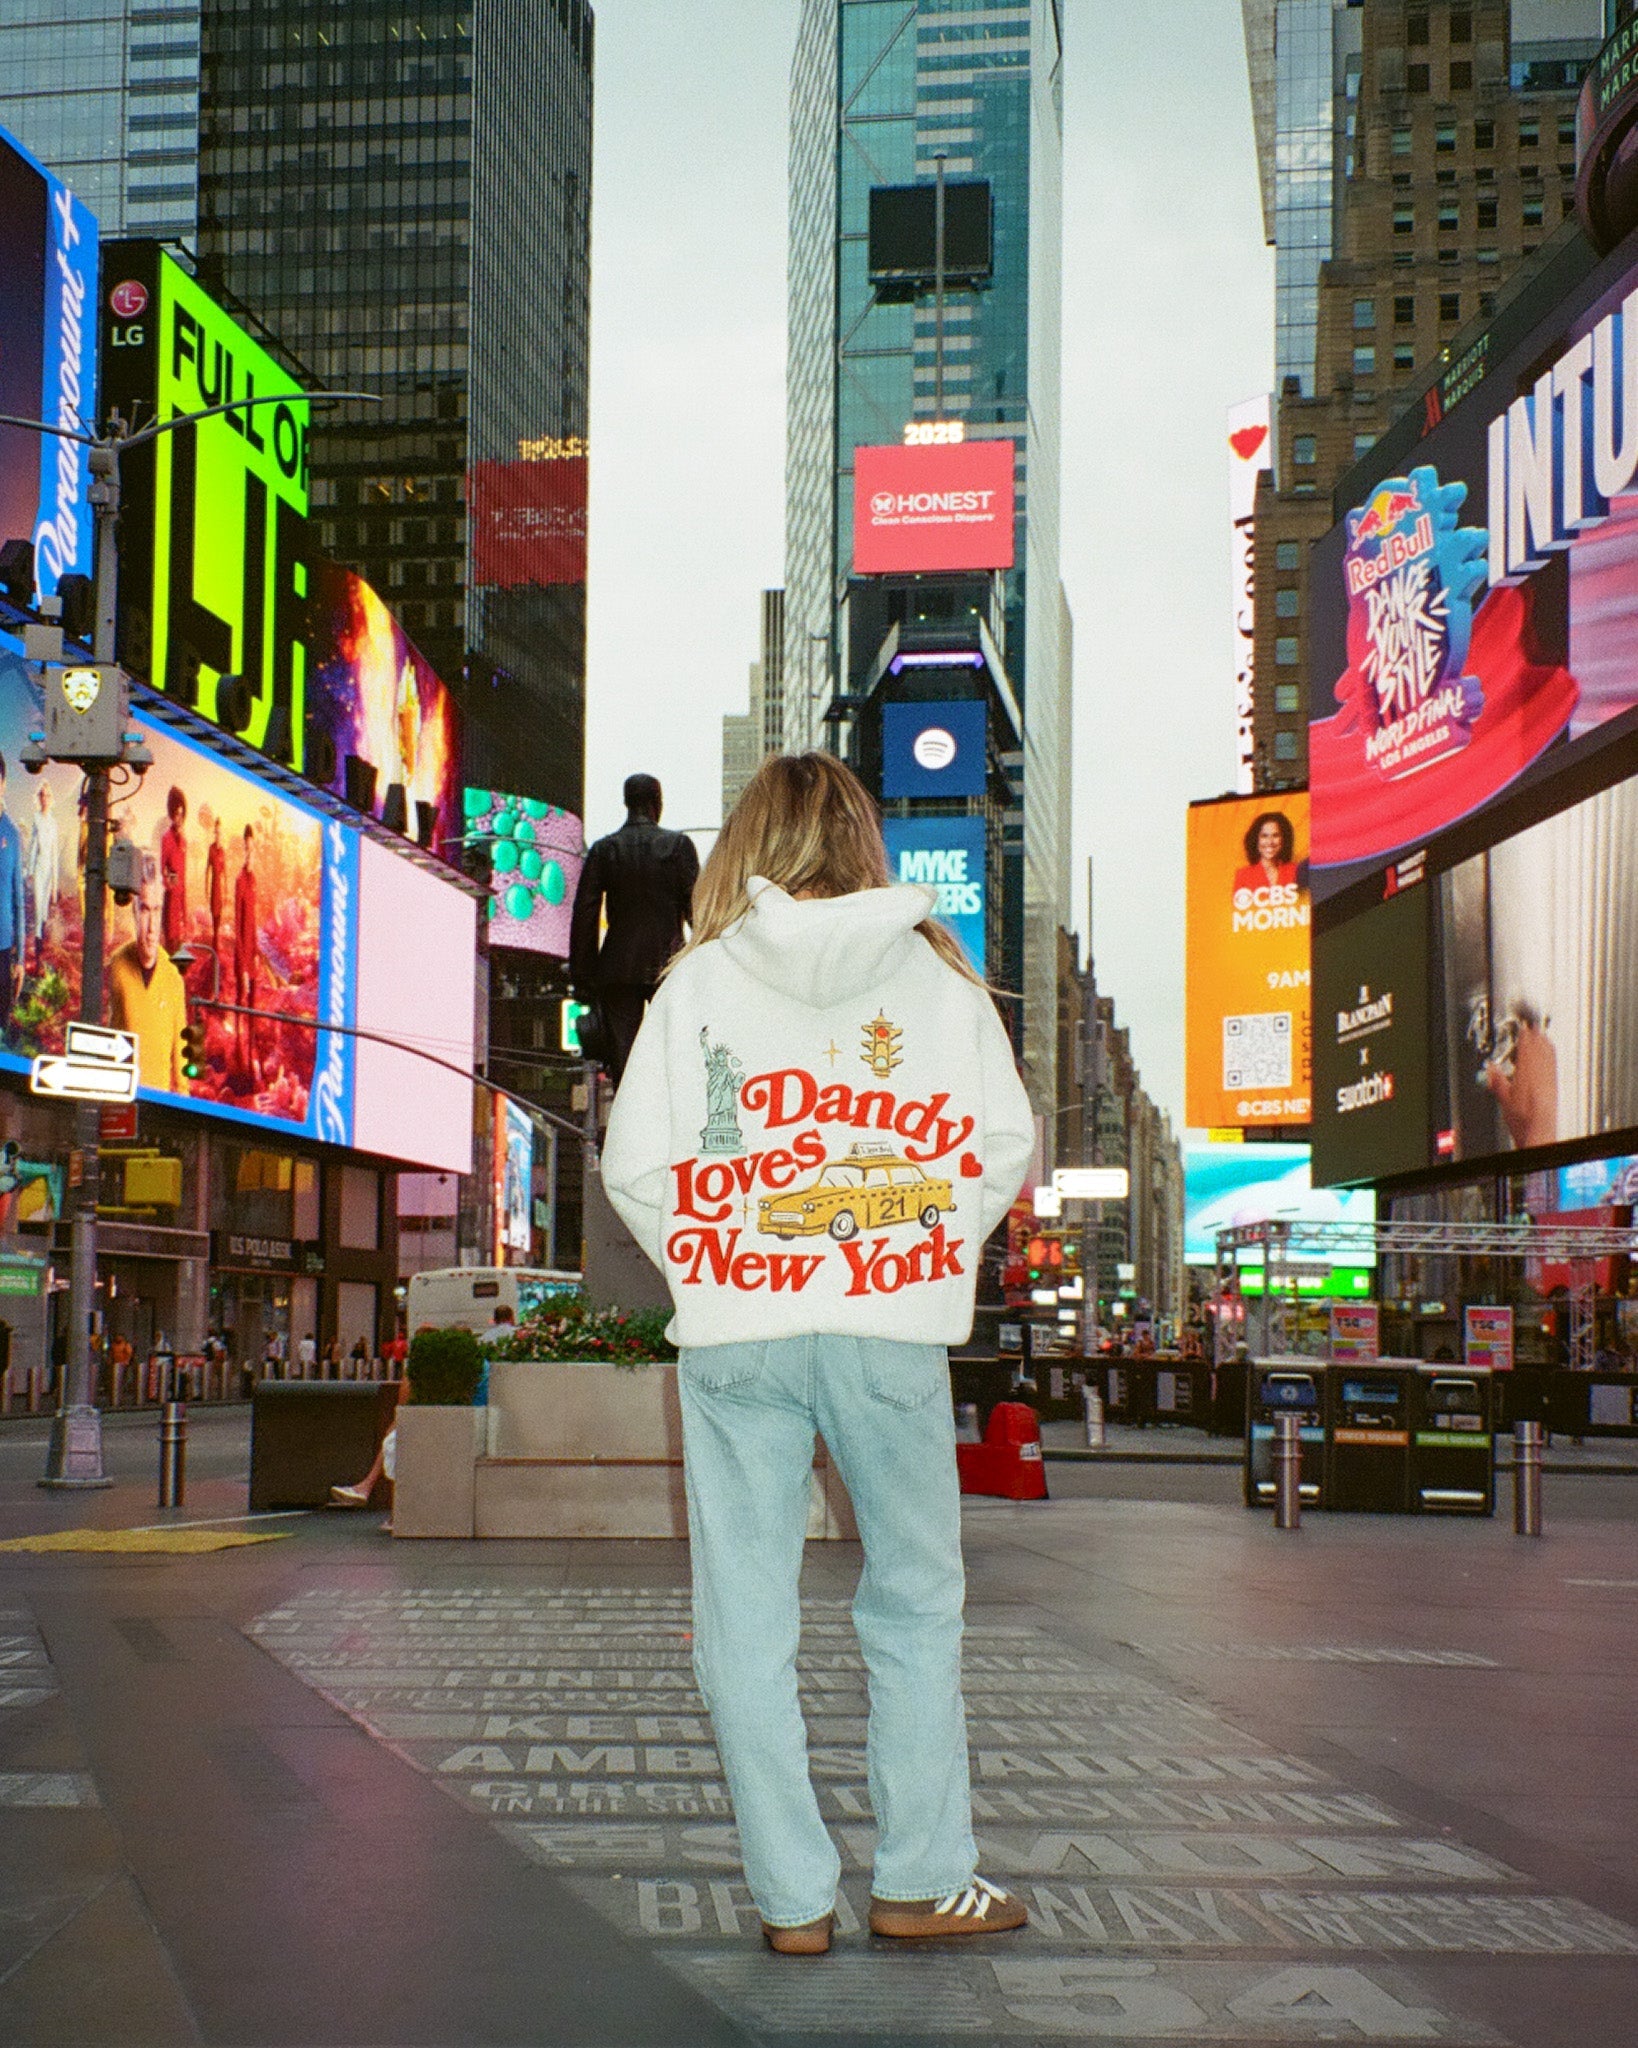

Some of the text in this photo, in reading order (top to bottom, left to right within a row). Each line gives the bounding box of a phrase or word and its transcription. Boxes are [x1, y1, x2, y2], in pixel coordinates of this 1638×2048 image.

[111, 326, 144, 347] LG
[173, 299, 265, 455] FULL
[904, 422, 964, 445] 2025
[898, 490, 995, 512] HONEST
[870, 516, 899, 526] Clean
[902, 514, 953, 525] Conscious
[1349, 513, 1434, 595] Red Bull
[1365, 558, 1431, 641] DANCE
[1366, 686, 1467, 761] WORLD FINAL
[1379, 724, 1451, 770] LOS ANGELES
[901, 850, 969, 882] MYKE
[1253, 883, 1298, 907] CBS
[1267, 968, 1311, 989] 9AM
[740, 1068, 975, 1162] Dandy
[1250, 1100, 1282, 1116] CBS
[670, 1128, 828, 1222] Loves
[879, 1197, 906, 1220] 21
[666, 1223, 965, 1297] New York
[489, 1797, 533, 1812] IN
[1254, 1890, 1578, 1918] AUGUST
[1274, 1911, 1638, 1955] WILSON
[989, 1960, 1451, 2038] 54
